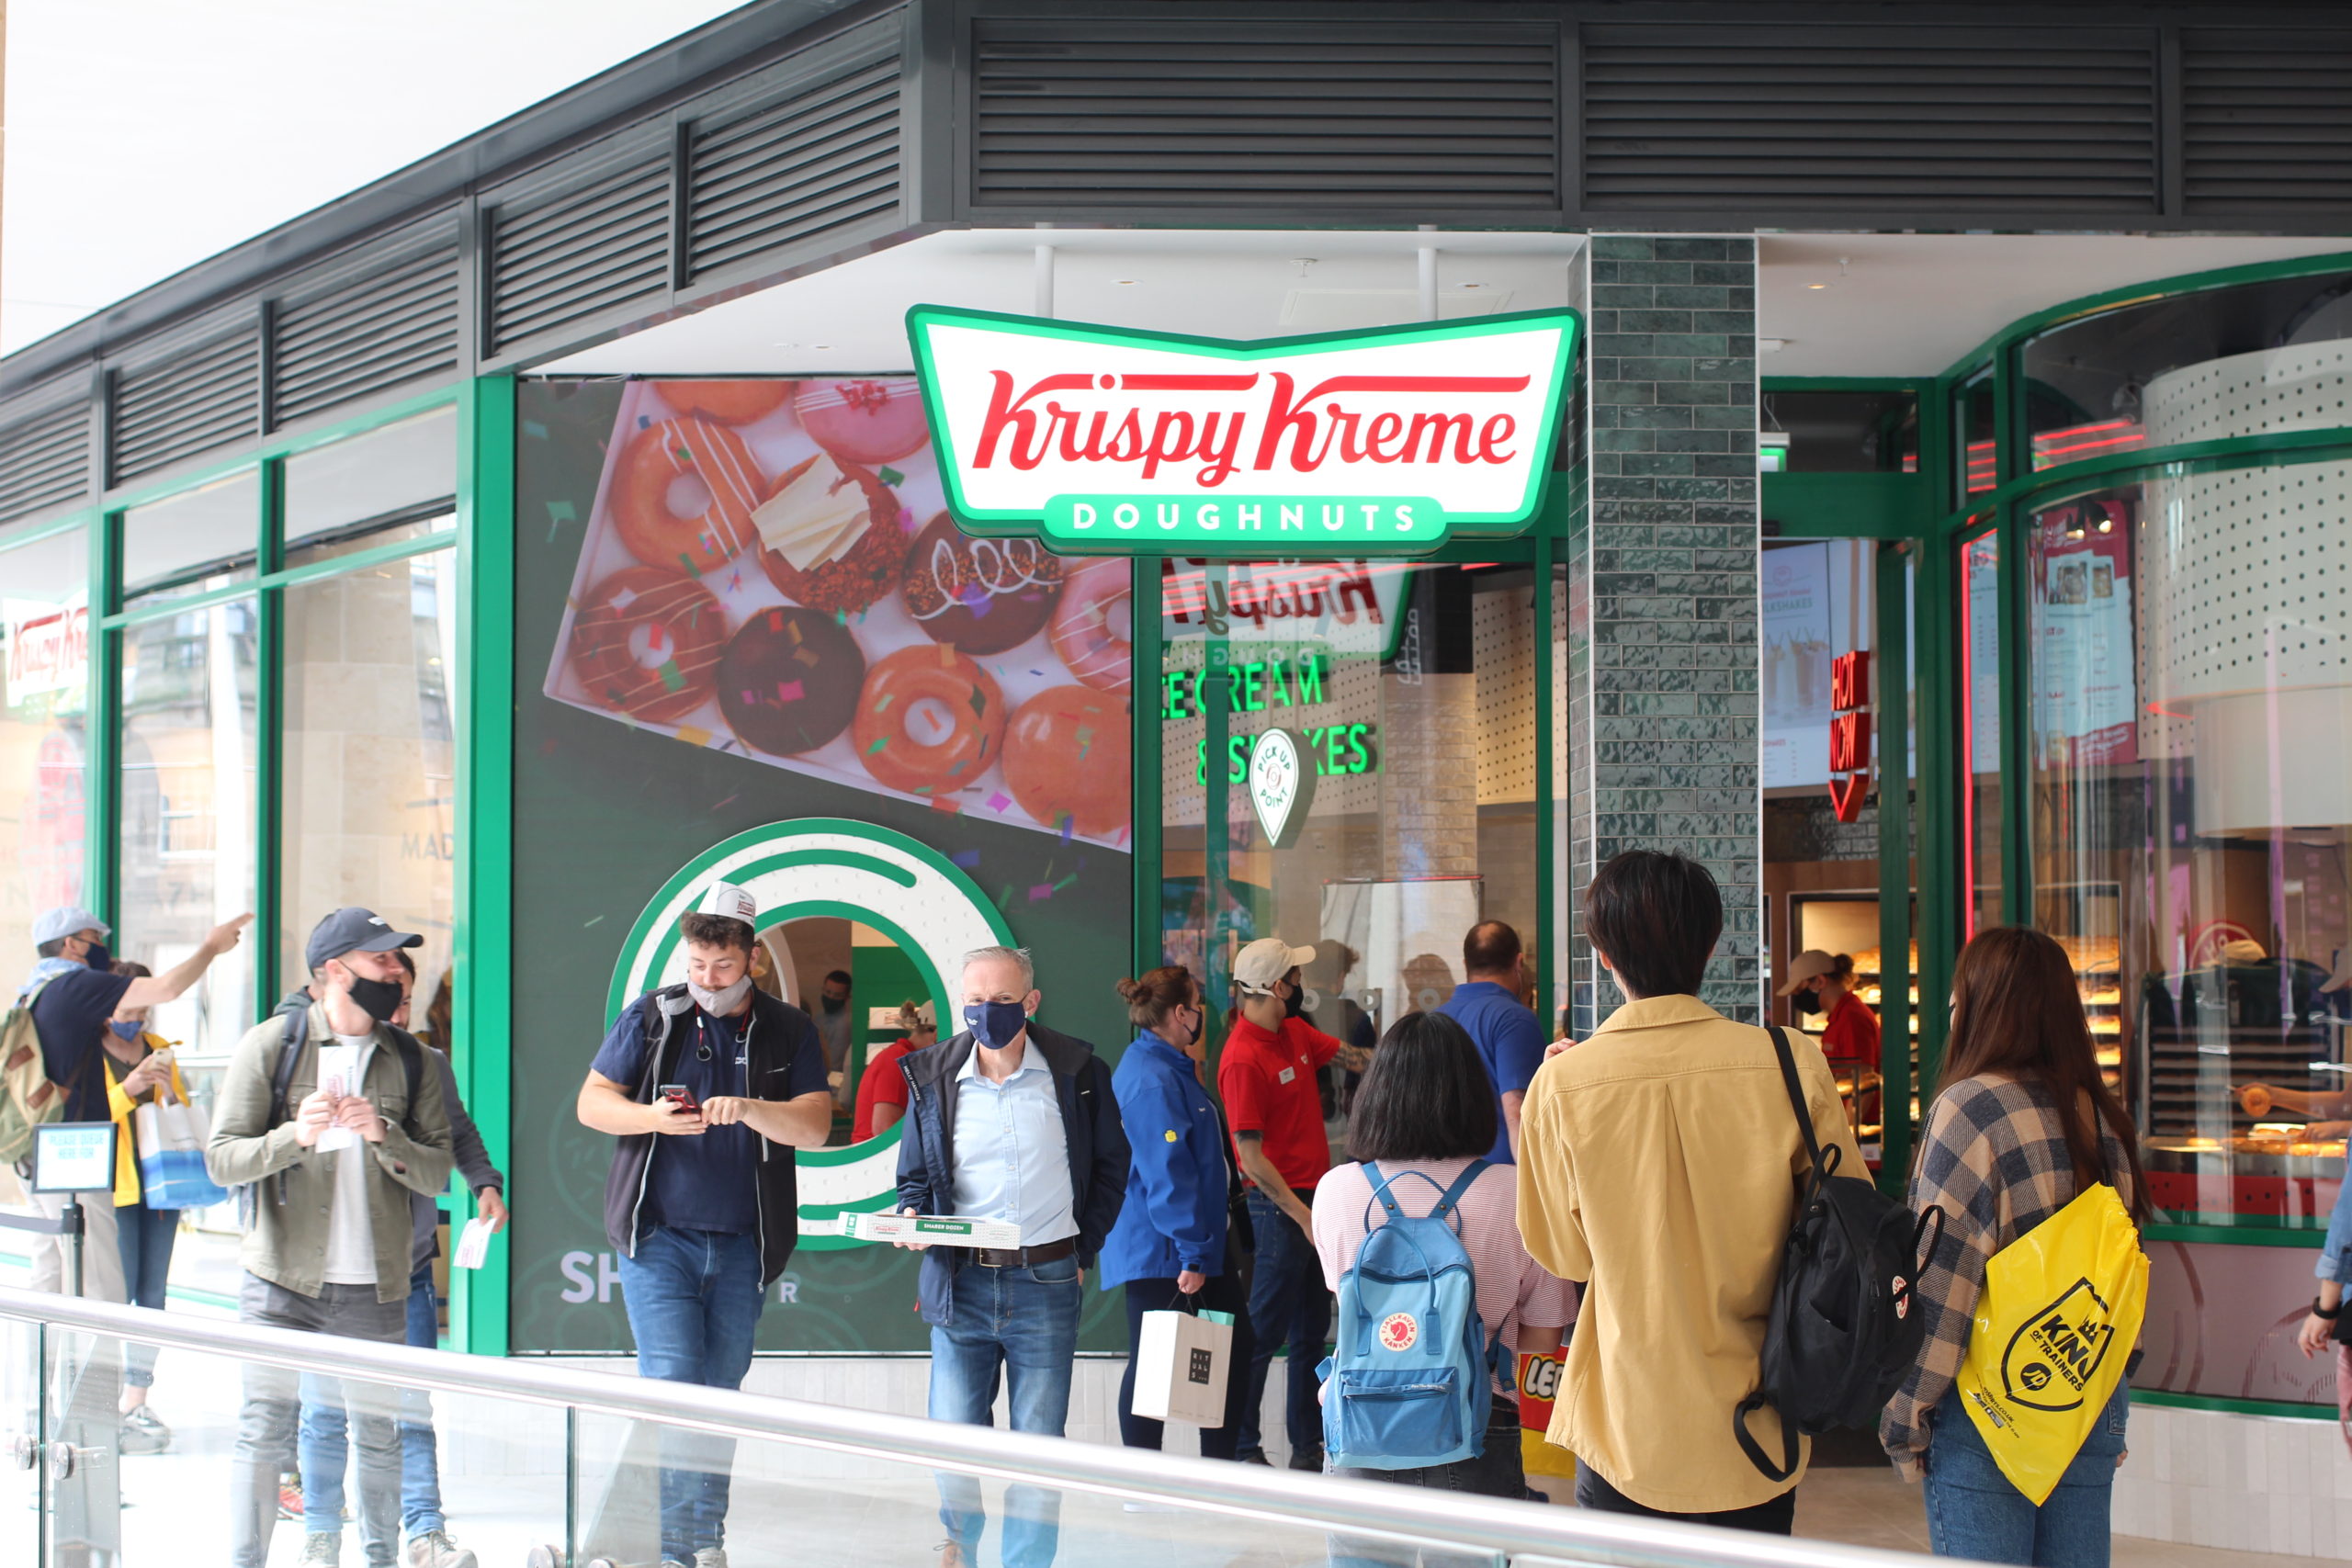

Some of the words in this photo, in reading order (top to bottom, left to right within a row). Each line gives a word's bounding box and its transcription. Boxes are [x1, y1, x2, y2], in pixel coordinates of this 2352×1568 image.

[972, 370, 1259, 488] Krispy
[1253, 371, 1531, 473] Kreme
[1073, 502, 1414, 532] DOUGHNUTS
[1831, 650, 1858, 711] HOT
[1228, 723, 1368, 784] SKES
[1258, 746, 1278, 772] PICK
[1279, 750, 1291, 771] UP
[1829, 712, 1859, 773] NOW
[1260, 787, 1288, 808] POINT
[923, 1223, 945, 1231] SHARER
[560, 1250, 622, 1304] SH
[1524, 1358, 1565, 1397] LE
[2022, 1368, 2051, 1389] JD
[2032, 1329, 2044, 1342] OF
[2039, 1341, 2084, 1393] TRAINERS
